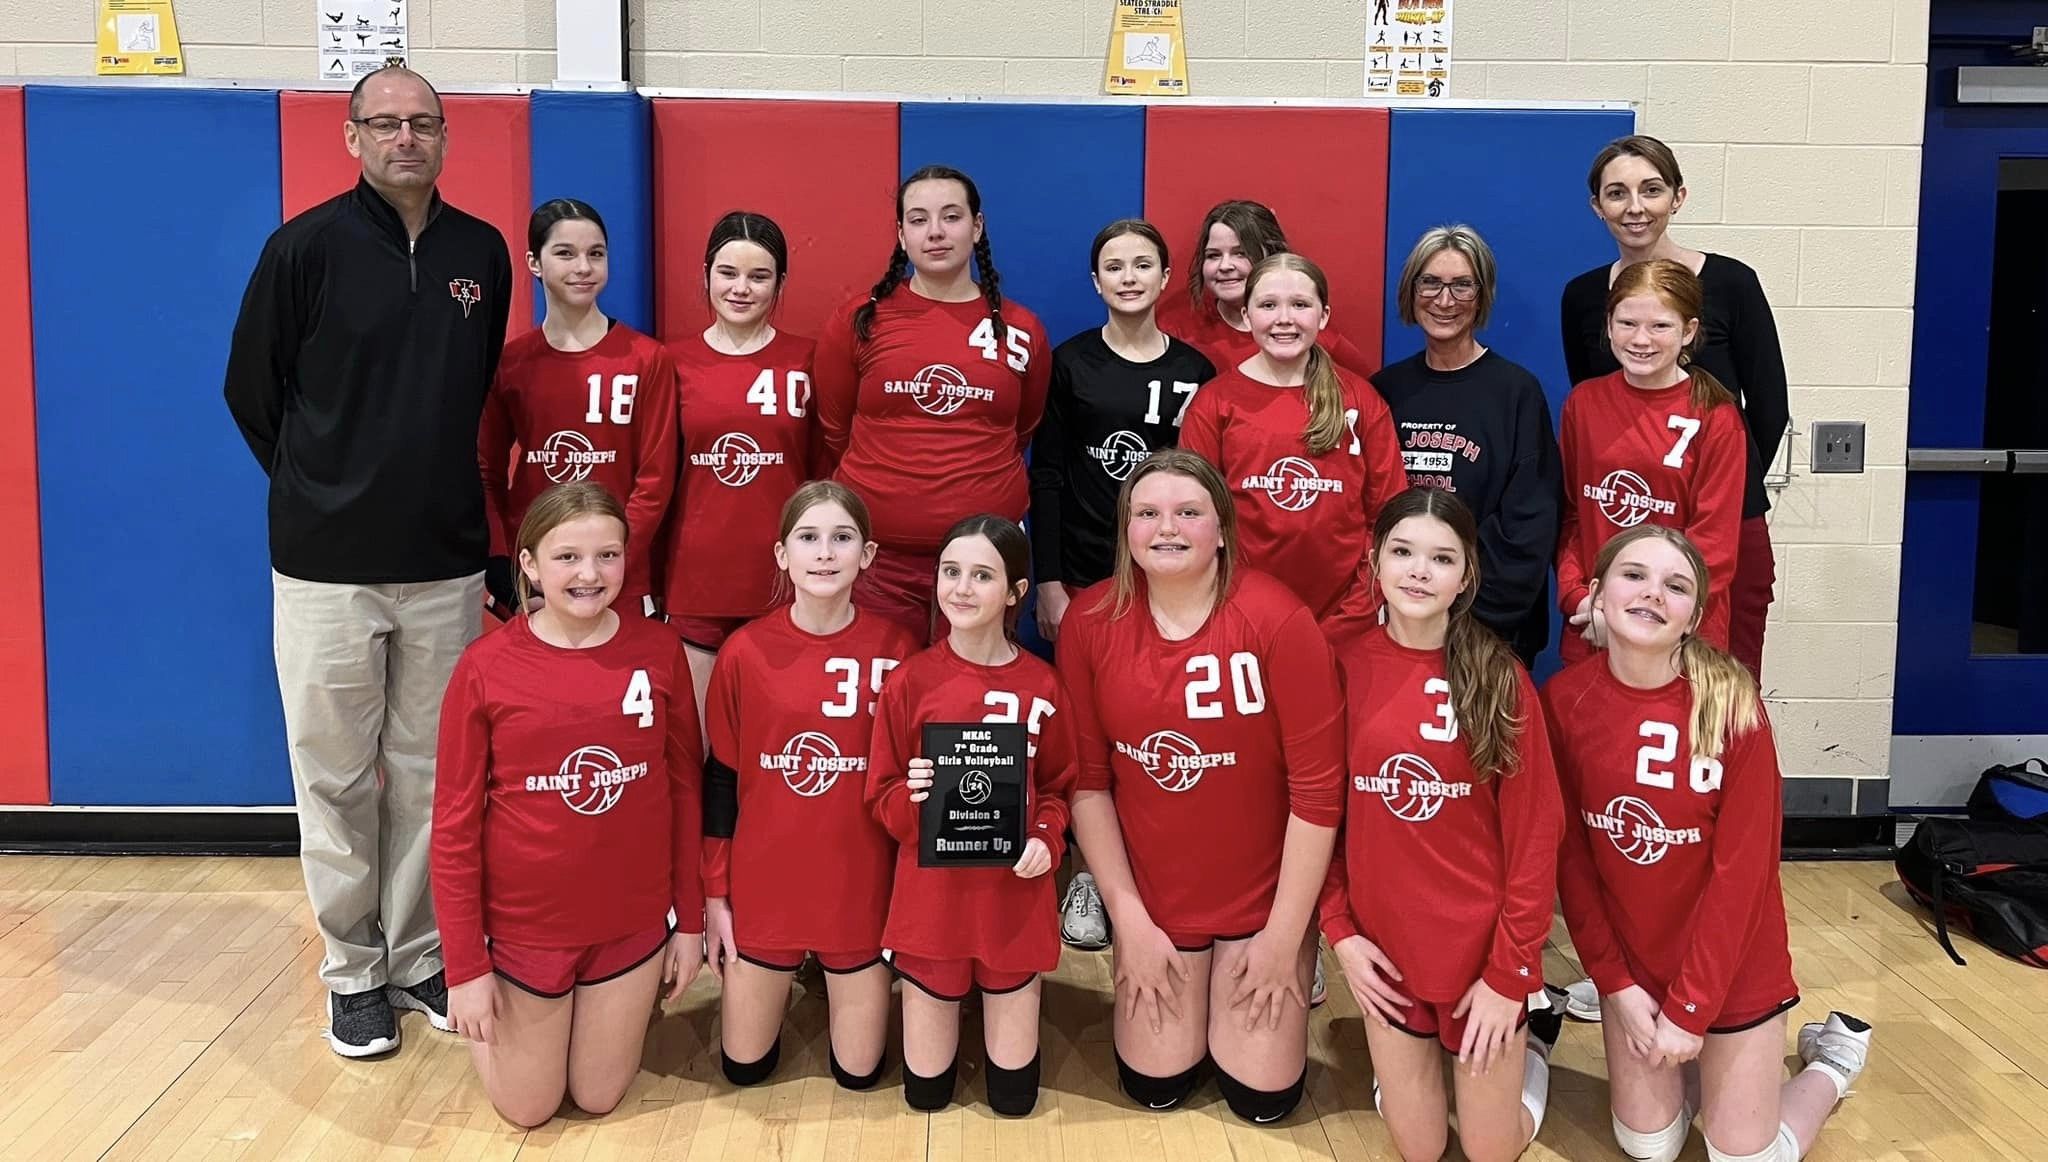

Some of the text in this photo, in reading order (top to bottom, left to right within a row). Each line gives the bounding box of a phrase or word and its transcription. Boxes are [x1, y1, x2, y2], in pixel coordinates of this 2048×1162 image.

[1134, 7, 1162, 15] STRECH
[968, 318, 1030, 372] 45
[585, 374, 638, 424] 18
[746, 369, 810, 417] 40
[884, 381, 994, 401] SAINT JOSEPH
[1144, 380, 1199, 427] 17
[1401, 422, 1456, 431] PROPERTY OF
[1405, 431, 1480, 462] JOSEPH
[1663, 414, 1701, 469] 7
[526, 450, 617, 463] AINT JOSEPH
[690, 452, 784, 466] SAINT JOSEPH
[1086, 445, 1153, 462] AINT JOS
[1402, 456, 1449, 466] ST. 1953
[1242, 475, 1343, 493] SAINT JOSEPH
[1620, 492, 1676, 515] JOSEPH
[822, 657, 900, 718] 35
[1185, 651, 1266, 719] 20
[622, 669, 654, 728] 4
[1420, 677, 1458, 742] 3
[962, 730, 991, 740] MKAC
[969, 743, 998, 753] Grade
[1116, 741, 1236, 769] SAINT JOSEPH
[806, 756, 867, 772] JOSEPH
[938, 755, 1014, 768] Girls Volleyball
[525, 761, 648, 791] SAINT JOSEPH
[1407, 779, 1472, 798] JOSEPH
[949, 809, 1001, 820] Division 3
[1581, 808, 1701, 845] AINT JOSEPH
[936, 837, 1012, 854] Runner Up
